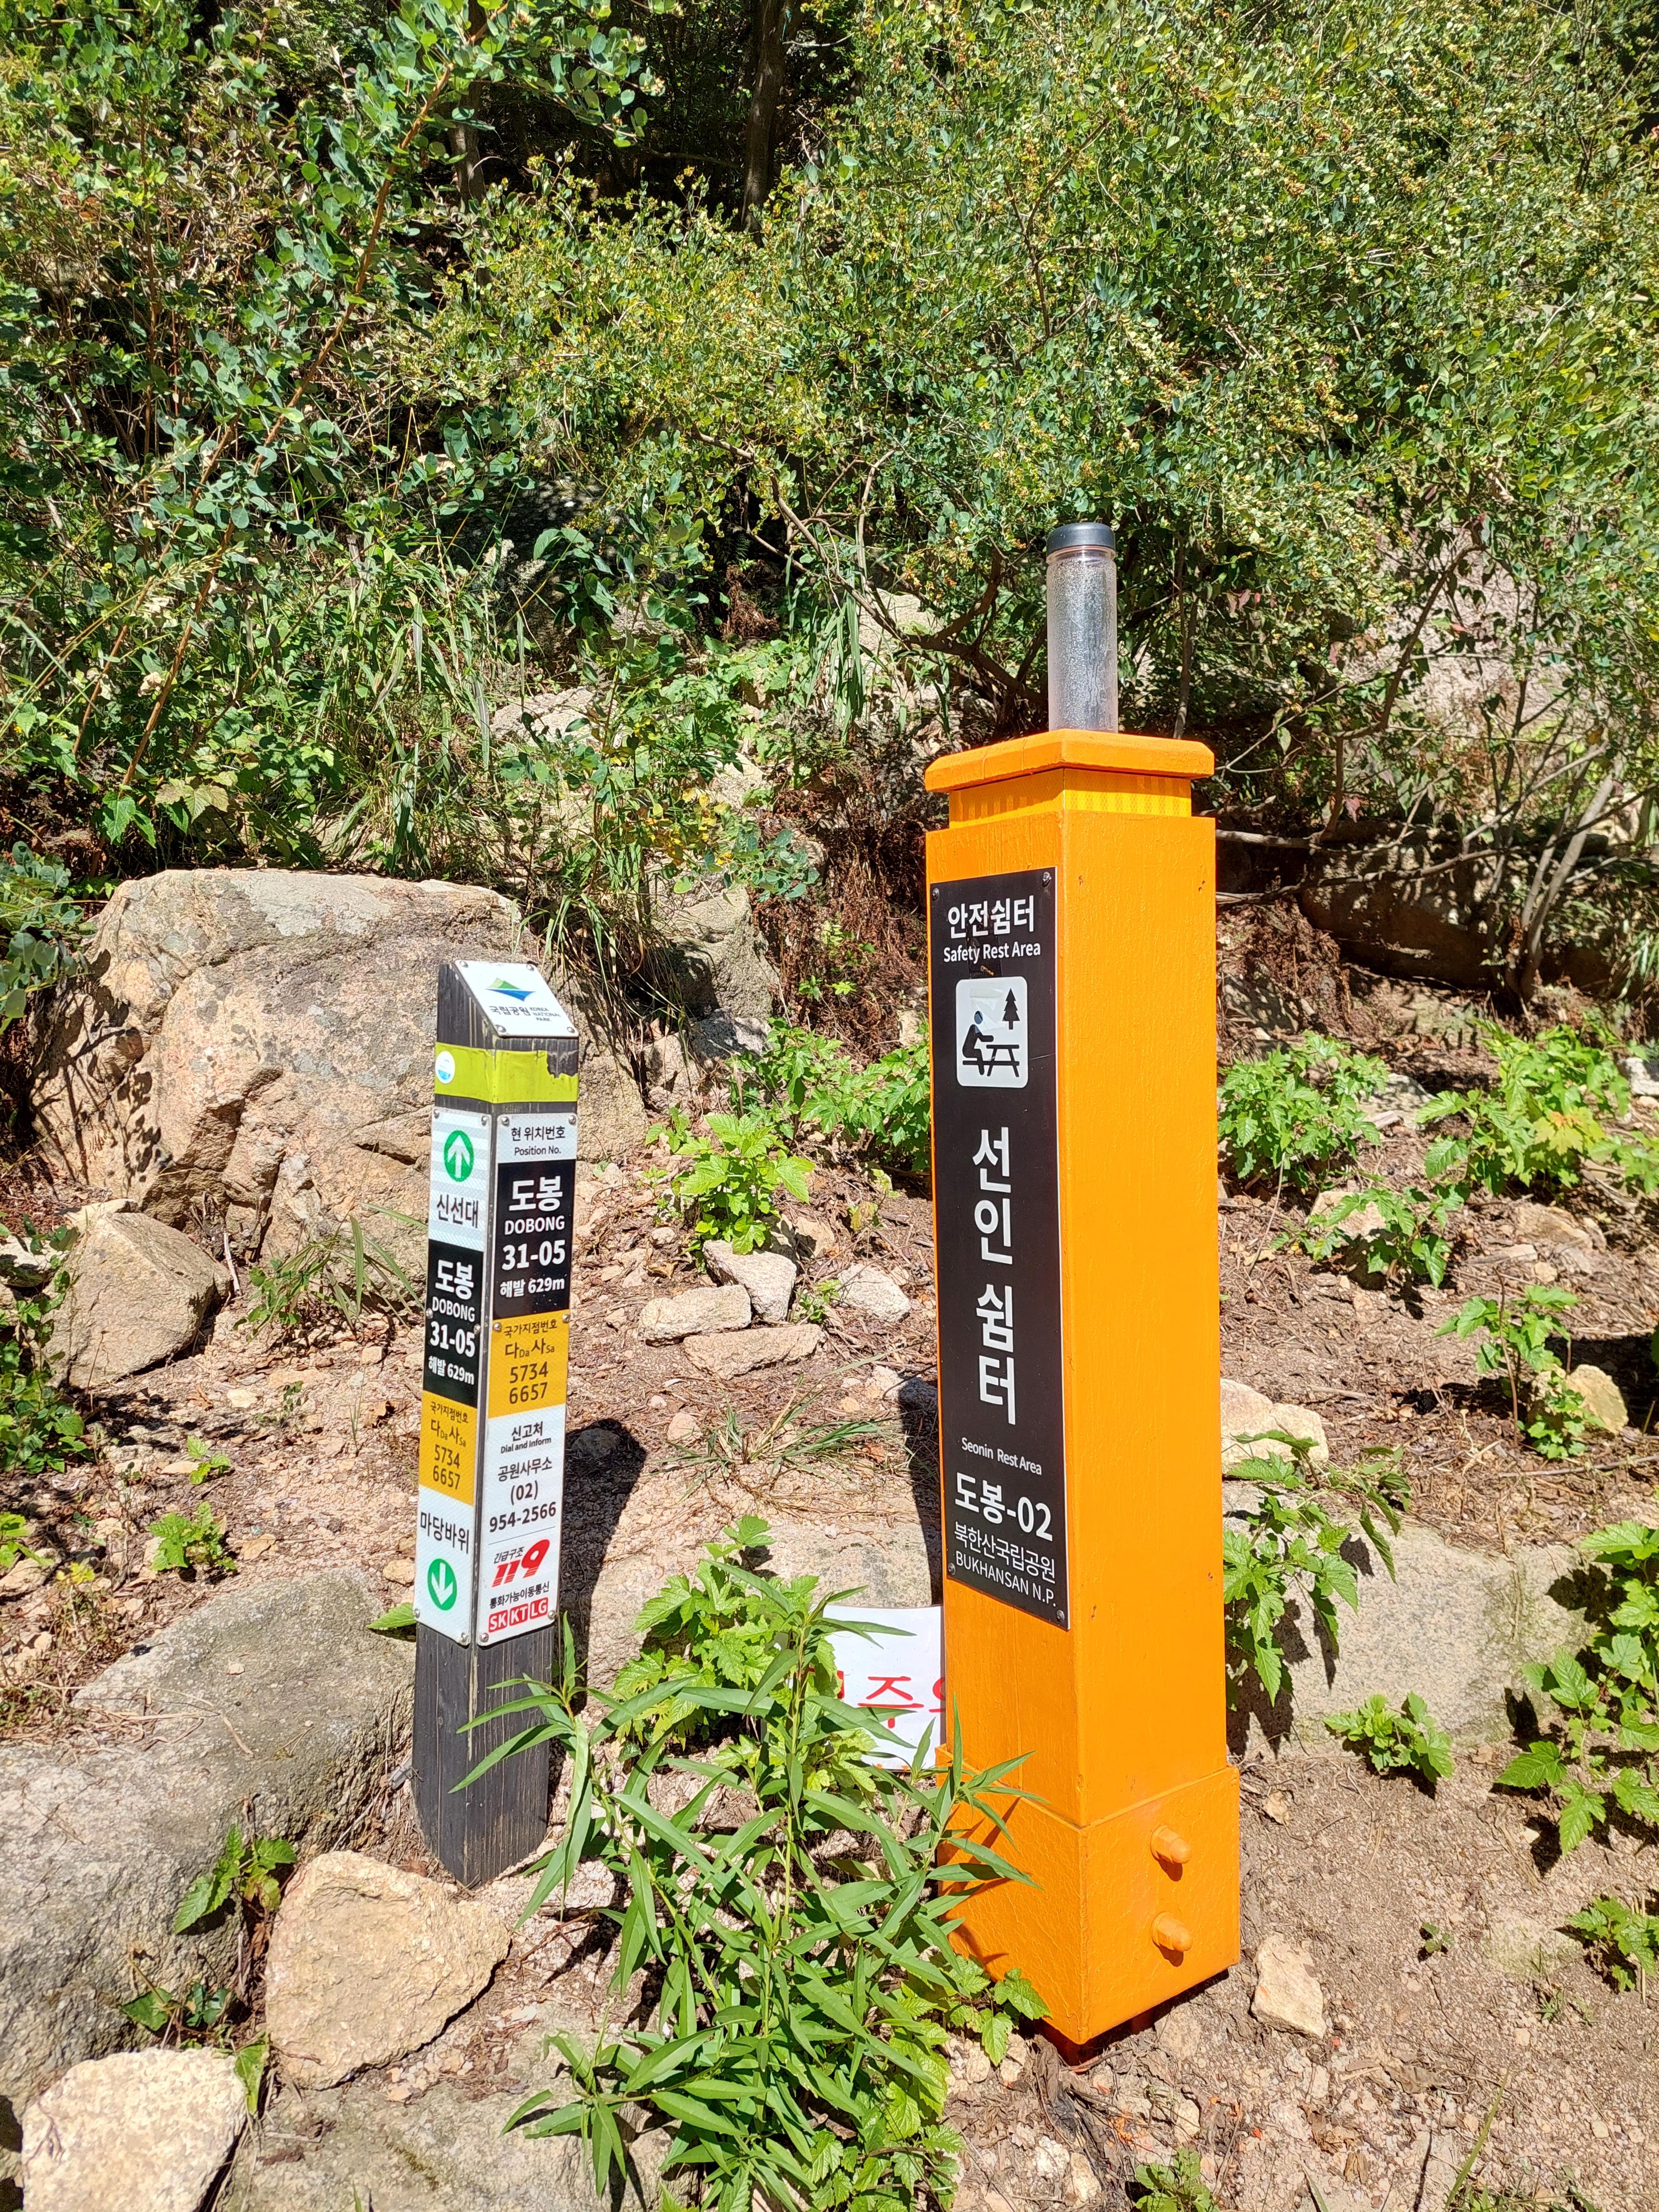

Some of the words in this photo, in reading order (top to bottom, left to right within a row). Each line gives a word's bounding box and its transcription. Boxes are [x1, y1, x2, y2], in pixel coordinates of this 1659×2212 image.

[948, 895, 1034, 939] 안전쉼터
[943, 945, 980, 964] Safety
[983, 942, 1009, 959] Rest
[1012, 941, 1040, 957] Area
[489, 1006, 531, 1016] 국립공원
[514, 1146, 547, 1156] Position
[548, 1145, 561, 1154] No.
[509, 1175, 563, 1212] 도봉
[437, 1194, 478, 1229] 신선대
[505, 1215, 565, 1235] DOBONG
[502, 1239, 565, 1271] 31-05
[434, 1259, 474, 1300] 도봉
[500, 1278, 526, 1298] 해발
[528, 1277, 565, 1294] 629m
[432, 1296, 476, 1322] DOBONG
[430, 1321, 476, 1358] 31-05
[504, 1319, 558, 1338] 국가지점번호
[428, 1355, 446, 1377] 해발
[447, 1361, 475, 1385] 629m
[509, 1361, 549, 1383] 5734
[509, 1382, 548, 1404] 6657
[430, 1401, 469, 1424] 국가지점번호
[511, 1421, 543, 1442] 신고처
[434, 1444, 460, 1469] 5734
[500, 1446, 514, 1454] Dial
[515, 1442, 527, 1451] and
[529, 1437, 552, 1448] Inform
[962, 1437, 994, 1460] Seonin
[997, 1448, 1018, 1469] Rest
[1019, 1456, 1042, 1475] Area
[433, 1466, 460, 1490] 6657
[498, 1457, 553, 1482] 공원사무소
[510, 1480, 539, 1505] (02)
[489, 1501, 556, 1533] 954-2566
[955, 1472, 1053, 1542] 도봉-02
[420, 1511, 469, 1555] 마당바위
[491, 1539, 550, 1588] 119
[494, 1546, 525, 1564] 긴급구조
[956, 1550, 1029, 1595] BUKHANSAN
[1032, 1582, 1057, 1607] N.P.
[489, 1613, 507, 1631] SK
[510, 1605, 528, 1622] KT
[531, 1600, 548, 1616] LG
